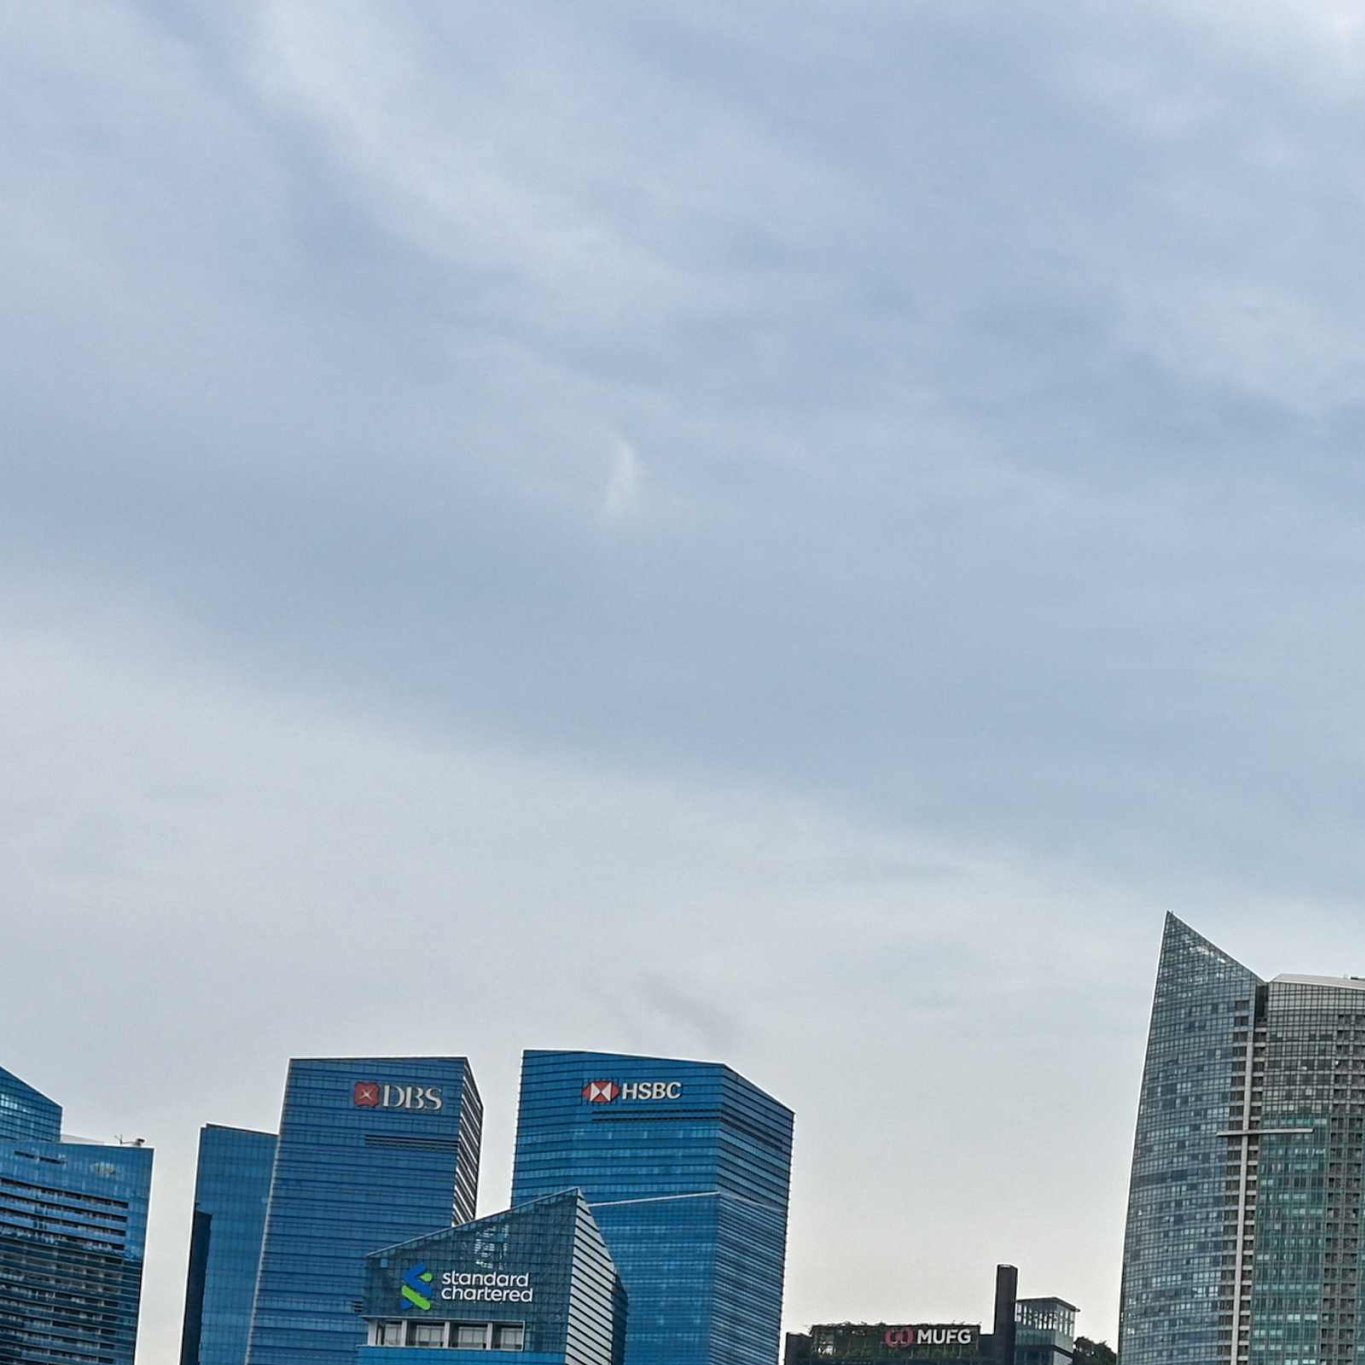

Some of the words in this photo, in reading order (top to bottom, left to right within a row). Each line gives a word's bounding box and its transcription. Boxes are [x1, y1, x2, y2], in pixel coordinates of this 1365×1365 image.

[382, 1084, 443, 1111] DBS
[621, 1082, 682, 1100] HSBC
[441, 1270, 529, 1287] standard
[441, 1285, 534, 1302] chartered
[917, 1328, 972, 1345] MUFG
